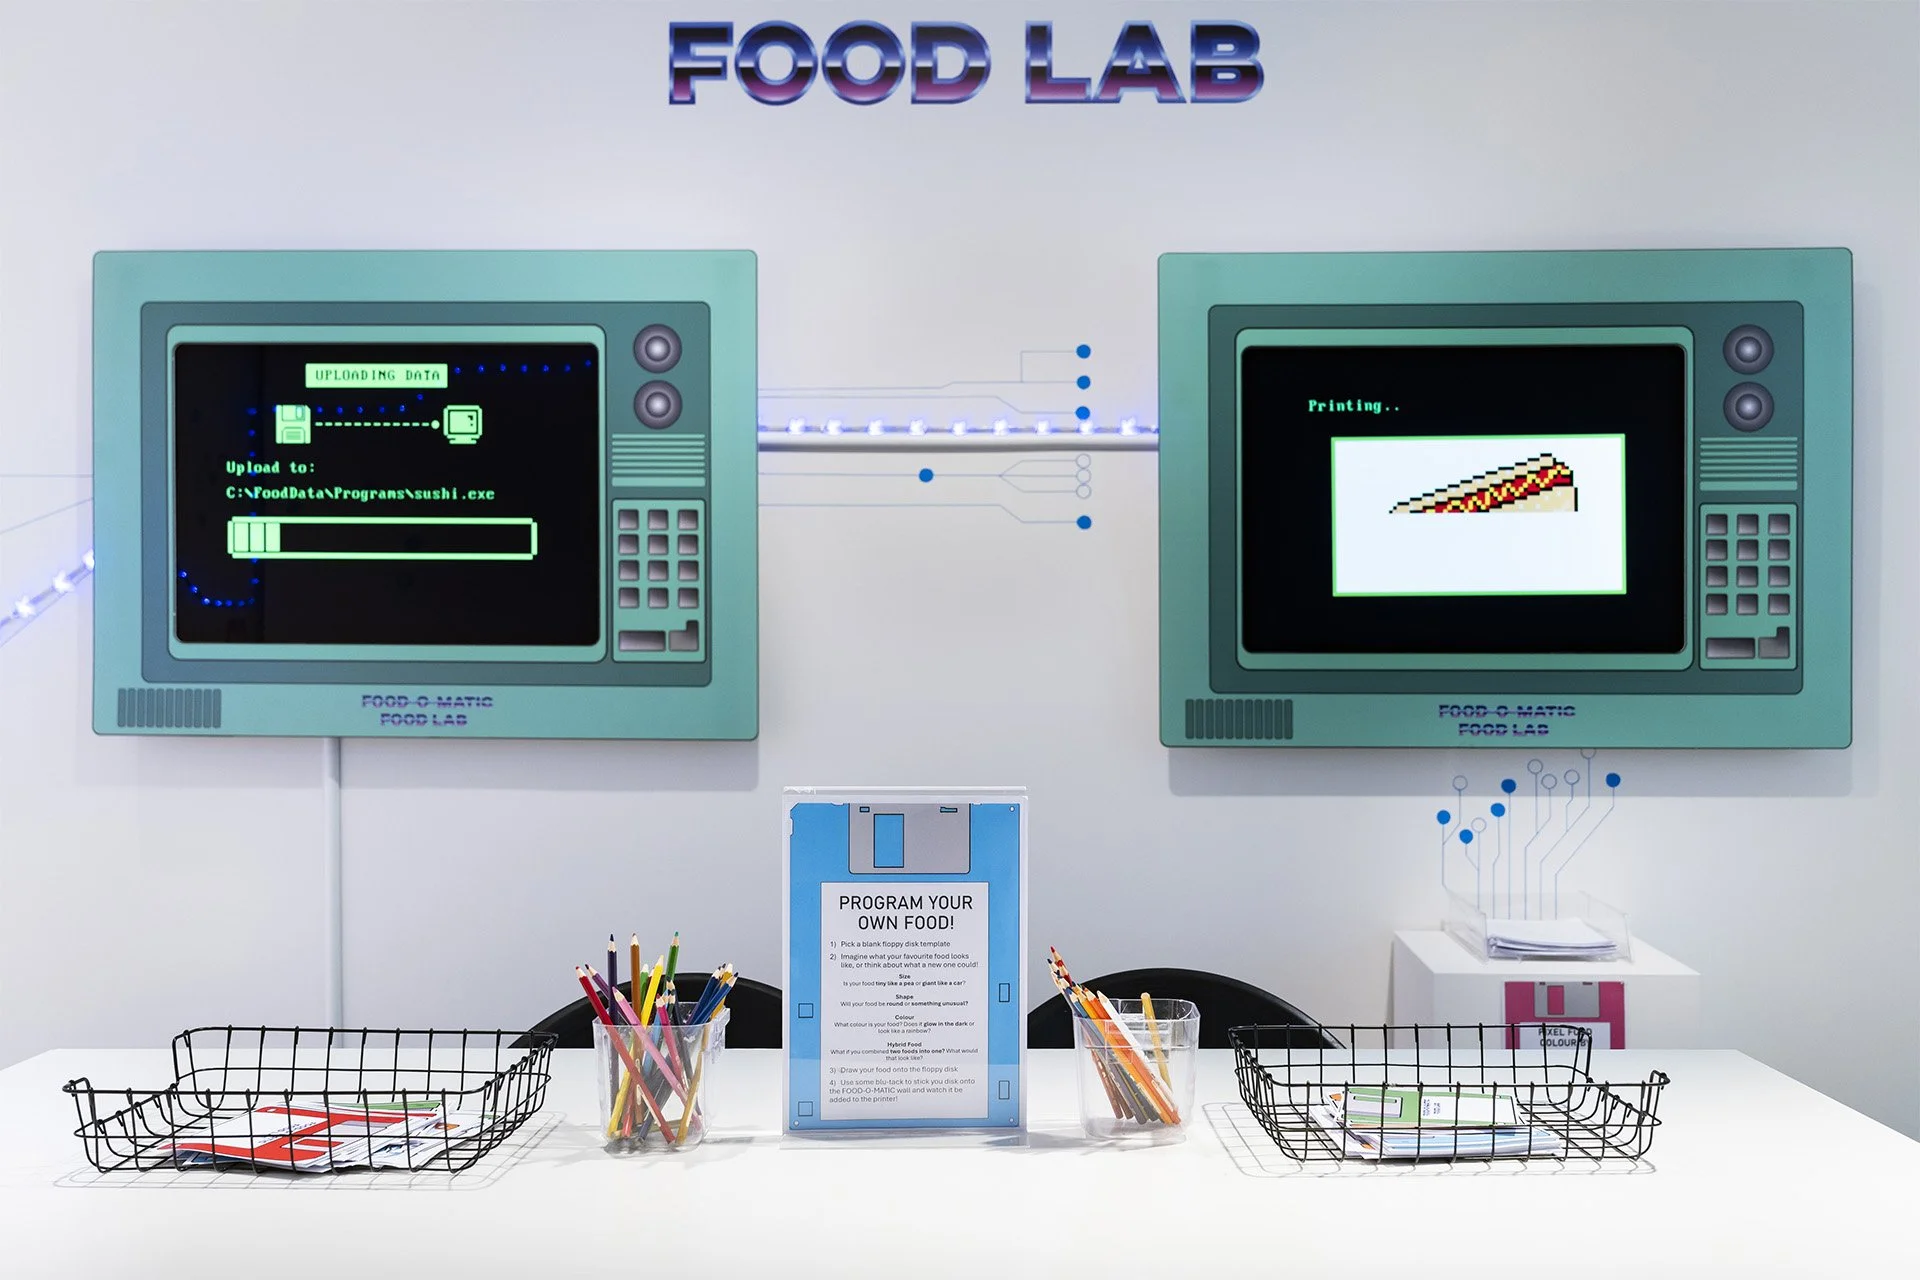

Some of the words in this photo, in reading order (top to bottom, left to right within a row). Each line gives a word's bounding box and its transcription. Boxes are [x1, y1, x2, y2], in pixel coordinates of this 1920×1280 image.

[668, 19, 991, 106] FOOD
[1025, 19, 1265, 105] LAB
[316, 369, 396, 381] UPLOADING
[405, 369, 441, 381] DATA
[1308, 398, 1401, 416] Printing..
[226, 461, 280, 475] Upload
[290, 462, 315, 474] to:
[226, 486, 495, 502] C:\FoodData\Programs\sushi.exe
[362, 695, 493, 708] FOOD-O-MATIC
[1439, 704, 1576, 718] FOOD-O-MATIC
[380, 713, 428, 726] FOOD
[432, 714, 467, 726] LAB
[1459, 723, 1507, 736] FOOD
[1513, 724, 1549, 736] LAB
[840, 896, 922, 910] PROGRAM
[929, 896, 972, 910] YOUR
[858, 916, 897, 930] OWN
[904, 916, 954, 930] FOOD!
